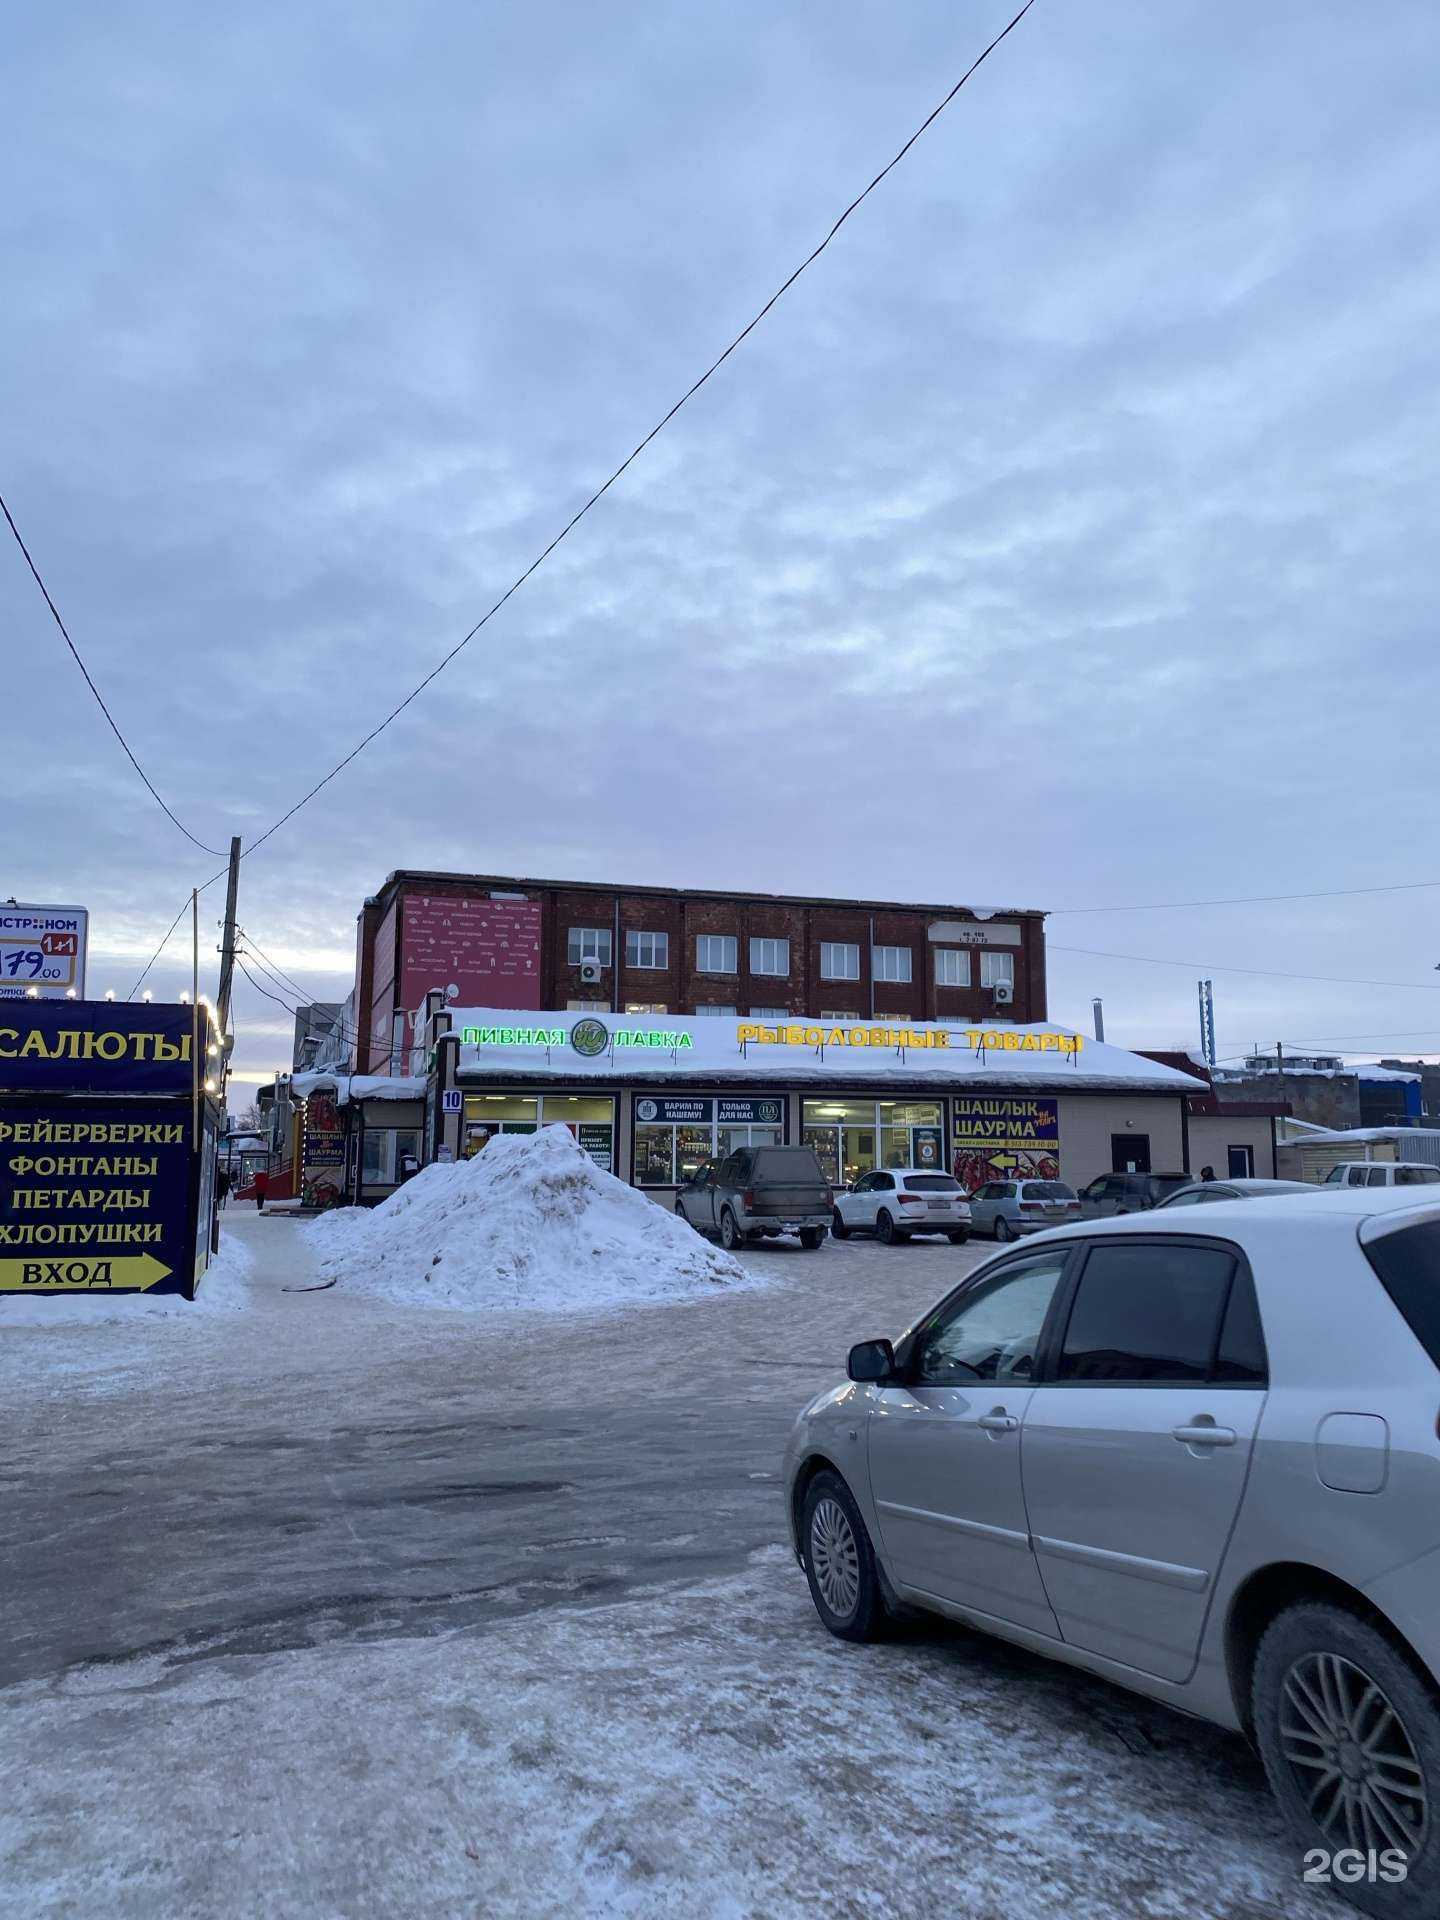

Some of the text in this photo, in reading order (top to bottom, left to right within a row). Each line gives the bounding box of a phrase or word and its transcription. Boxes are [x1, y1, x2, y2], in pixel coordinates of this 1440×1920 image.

[43, 935, 74, 953] 1+1
[0, 1030, 191, 1061] САЛЮТЫ
[461, 1026, 566, 1046] ПИВНАЯ
[615, 1029, 693, 1048] ЛАВКА
[737, 1024, 1084, 1053] РЫБОЛОВНЫЕ ТОВАРЫ
[445, 1092, 460, 1108] 10
[954, 1100, 1038, 1116] ШАШЛЫК
[666, 1111, 702, 1119] НАШЕМУ!
[737, 1111, 754, 1119] НАС!
[0, 1119, 183, 1145] ФЕЙЕРВЕРКИ
[955, 1120, 1036, 1137] ШАУРМА
[8, 1155, 158, 1176] ФОНТАНЫ
[12, 1189, 151, 1213] ПЕТАРДЫ
[0, 1223, 162, 1245] ХЛОПУШКИ
[22, 1262, 112, 1288] ВХОД
